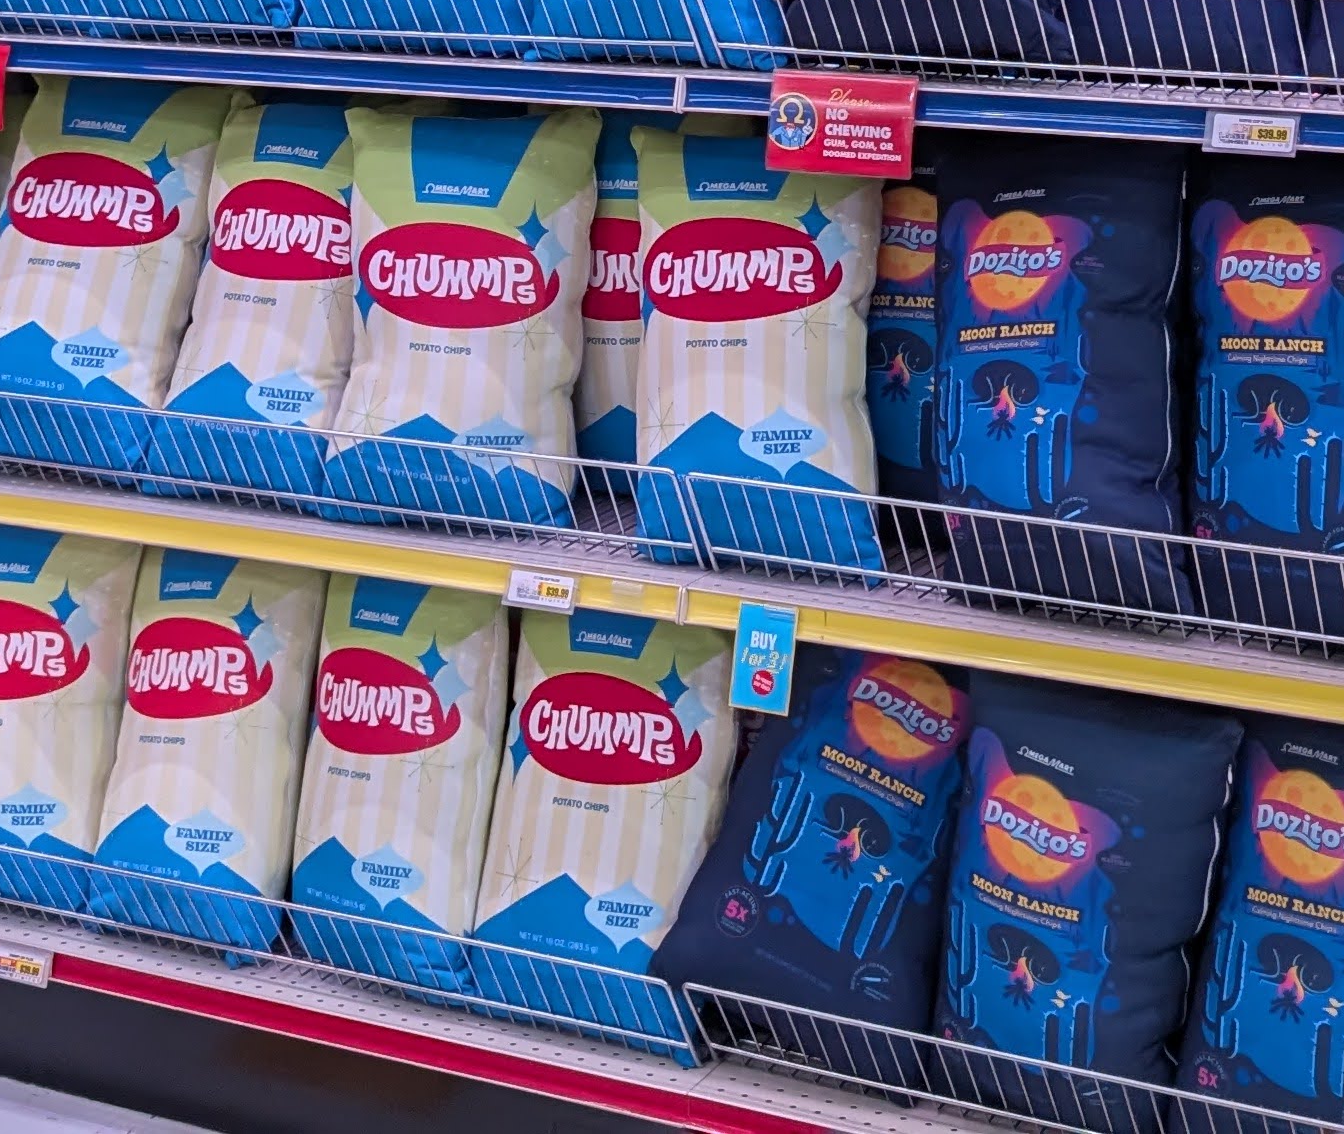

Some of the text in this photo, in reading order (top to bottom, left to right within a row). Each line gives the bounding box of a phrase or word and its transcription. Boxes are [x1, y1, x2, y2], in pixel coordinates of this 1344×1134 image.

[826, 108, 848, 121] NO
[825, 124, 892, 139] CHEWING
[1258, 129, 1287, 140] $39.99
[824, 139, 893, 151] GUM, GOM, OR
[1219, 255, 1321, 282] Dozito's
[62, 342, 118, 360] FAMILY
[409, 342, 472, 356] POTATO CHIPS
[70, 355, 105, 368] SIZE
[750, 631, 777, 650] BUY
[552, 797, 610, 813] POTATO CHIPS
[175, 827, 233, 844] FAMILY
[984, 798, 1087, 859] Dozito's
[185, 839, 220, 853] SIZE
[597, 899, 653, 917] FAMILY
[606, 914, 640, 929] SIZE
